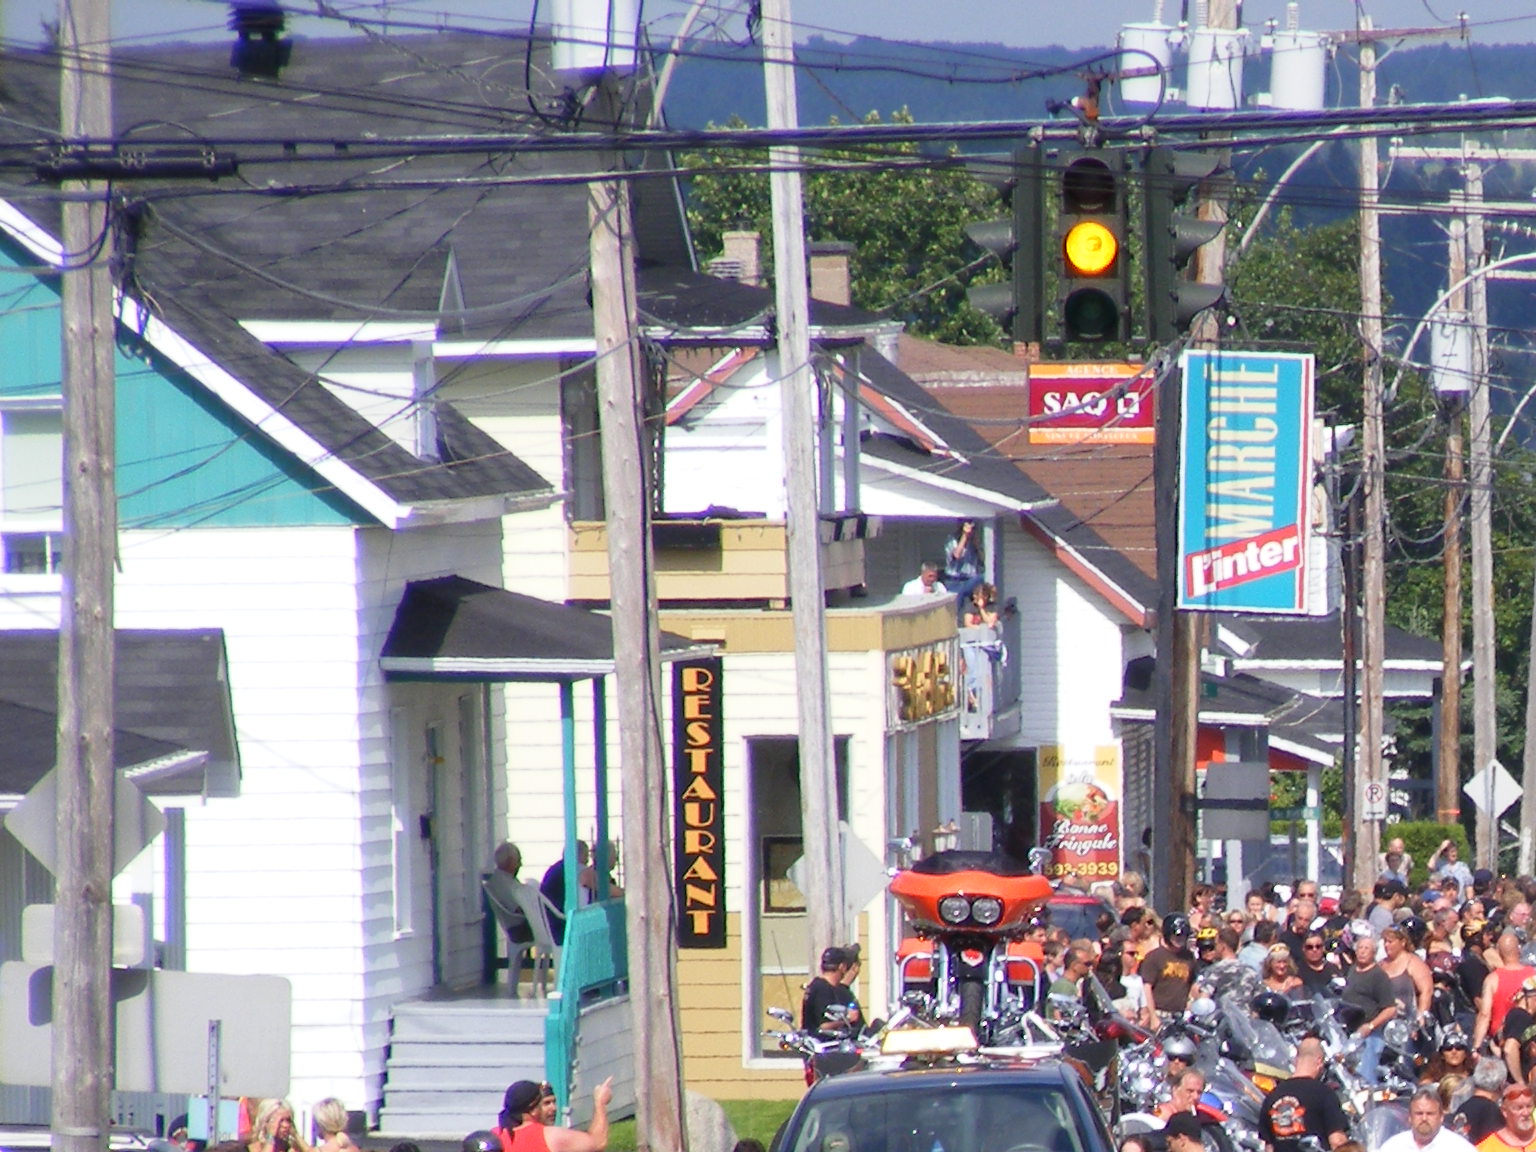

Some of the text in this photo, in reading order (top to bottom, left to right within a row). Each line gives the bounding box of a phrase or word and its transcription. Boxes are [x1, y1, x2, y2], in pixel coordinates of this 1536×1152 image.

[1043, 391, 1108, 417] SAQ
[1190, 535, 1299, 597] L'inter
[681, 667, 718, 935] RESTAURANT
